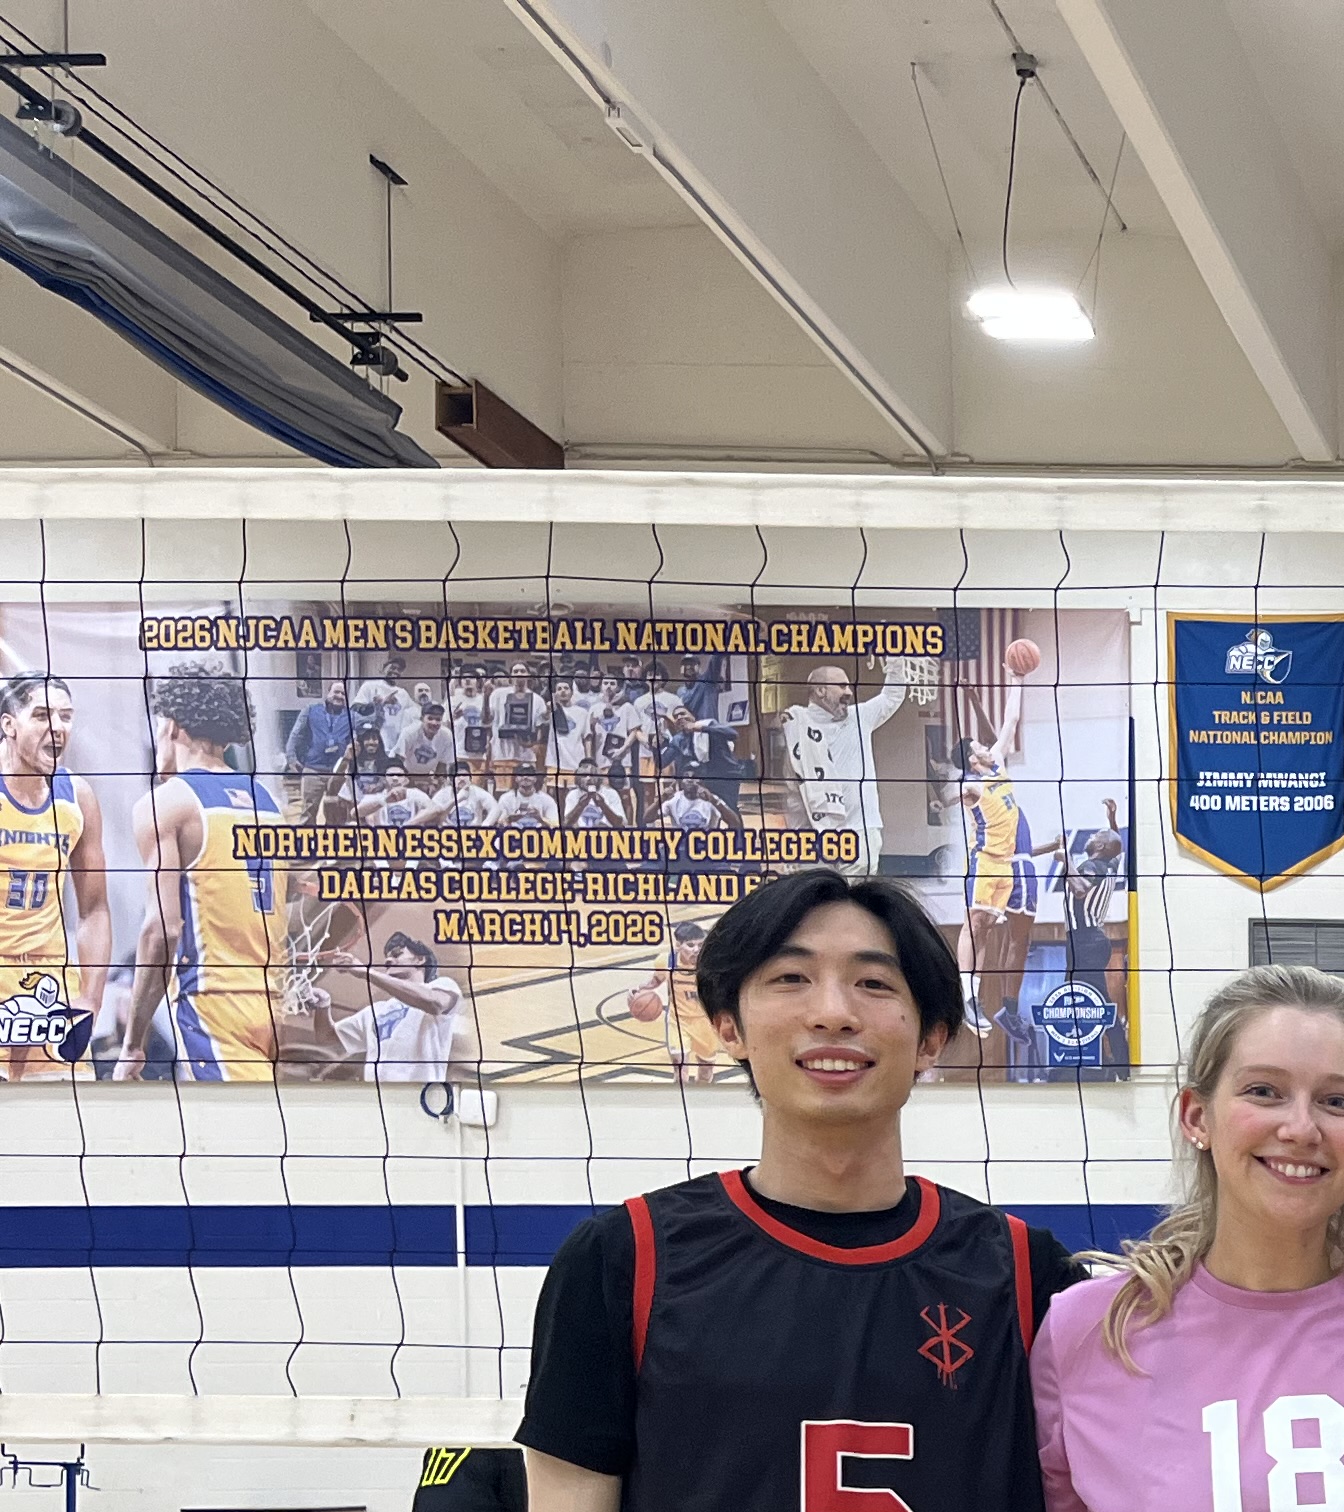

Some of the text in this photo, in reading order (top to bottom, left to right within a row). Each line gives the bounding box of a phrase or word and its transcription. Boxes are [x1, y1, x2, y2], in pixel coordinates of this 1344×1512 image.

[144, 618, 945, 656] 2026 NJCAA MEN'S BASKETBALL NATIONAL CHAMPIONS
[1228, 655, 1276, 670] NECC
[1212, 711, 1256, 725] TRACK
[1273, 711, 1312, 725] FIELD
[1189, 730, 1333, 745] NATIONAL CHAMPION
[1196, 772, 1254, 788] JIMMY
[1189, 795, 1335, 811] 400 METERS 2006
[235, 827, 858, 862] NORTHERN ESSEX COMMUNITY COLLEGE 68
[321, 870, 437, 900] DALLAS
[436, 911, 662, 945] MARCH 14, 2026
[1043, 1006, 1106, 1020] CHAMPIONSHIP
